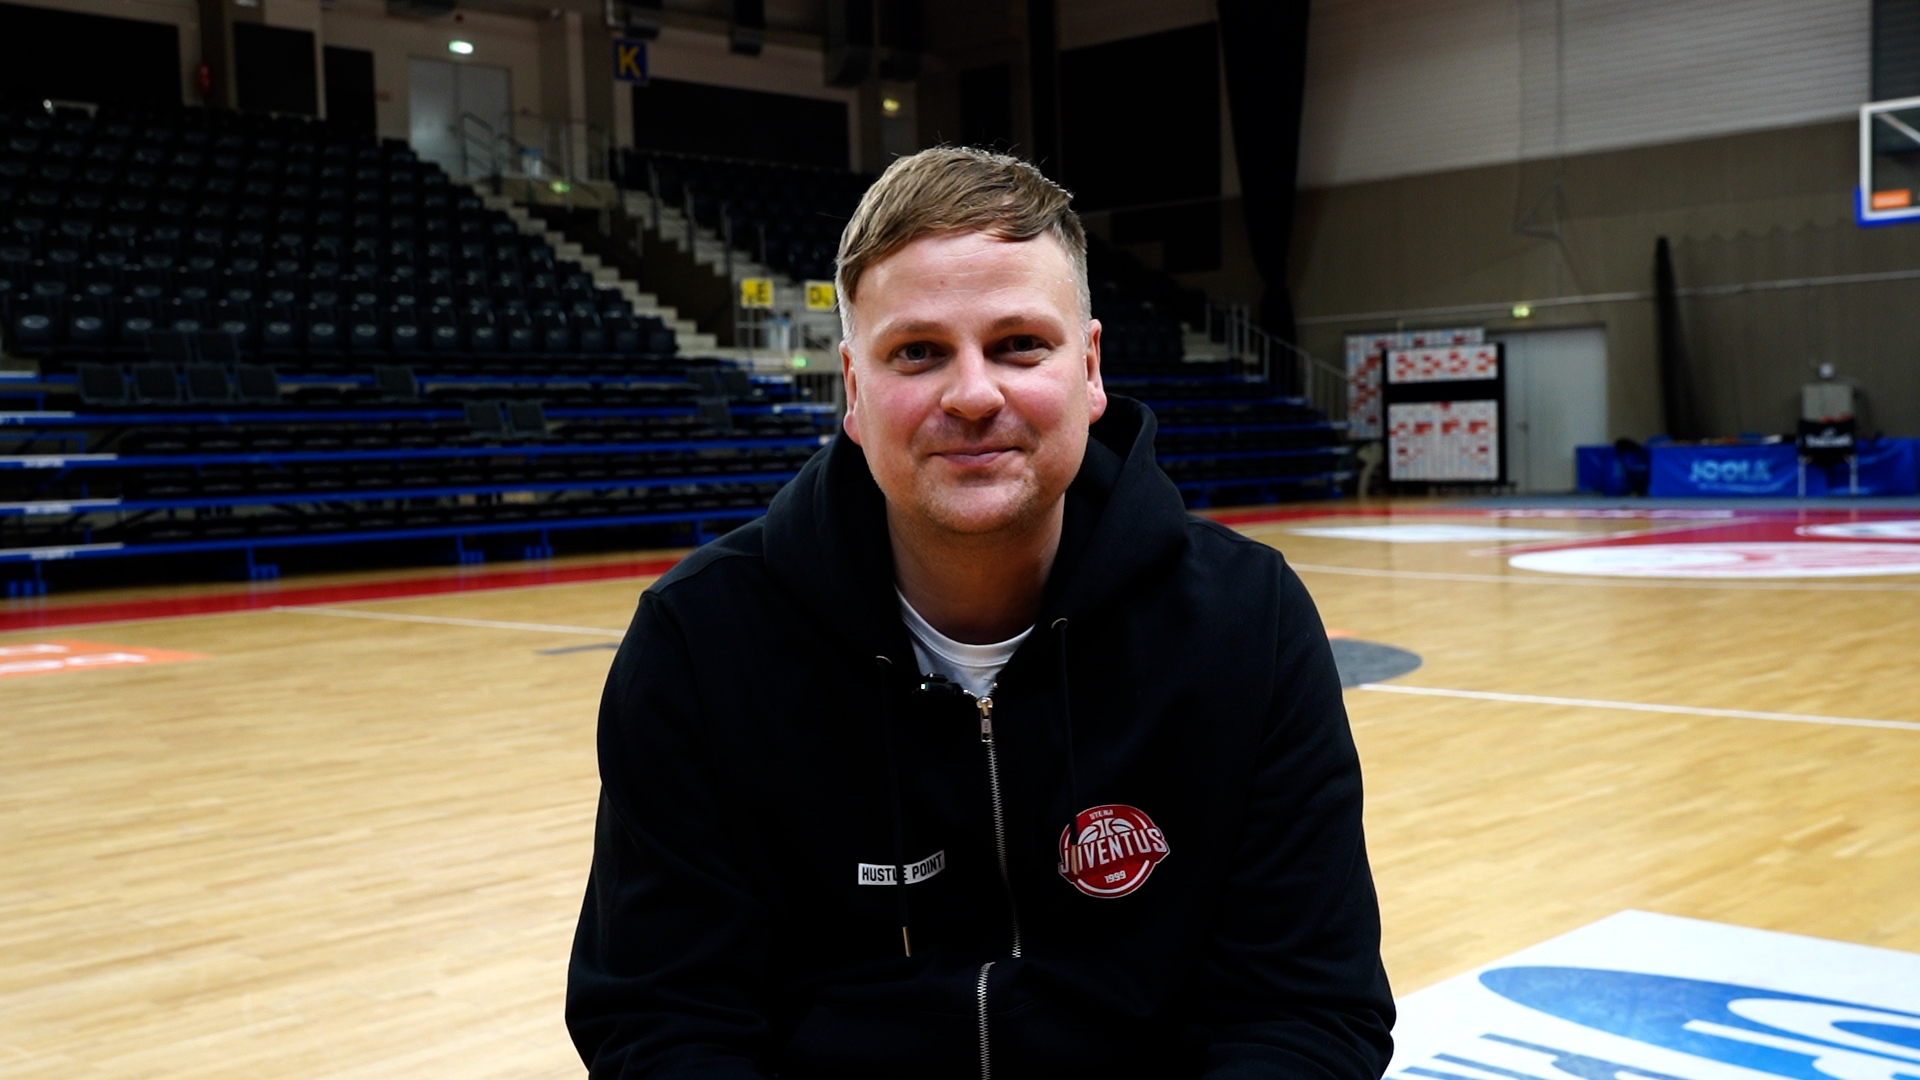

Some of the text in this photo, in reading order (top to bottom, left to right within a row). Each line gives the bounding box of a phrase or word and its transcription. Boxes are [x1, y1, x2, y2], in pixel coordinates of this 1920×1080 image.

[618, 44, 641, 78] K
[911, 852, 943, 880] POINT
[1104, 870, 1127, 884] 1999
